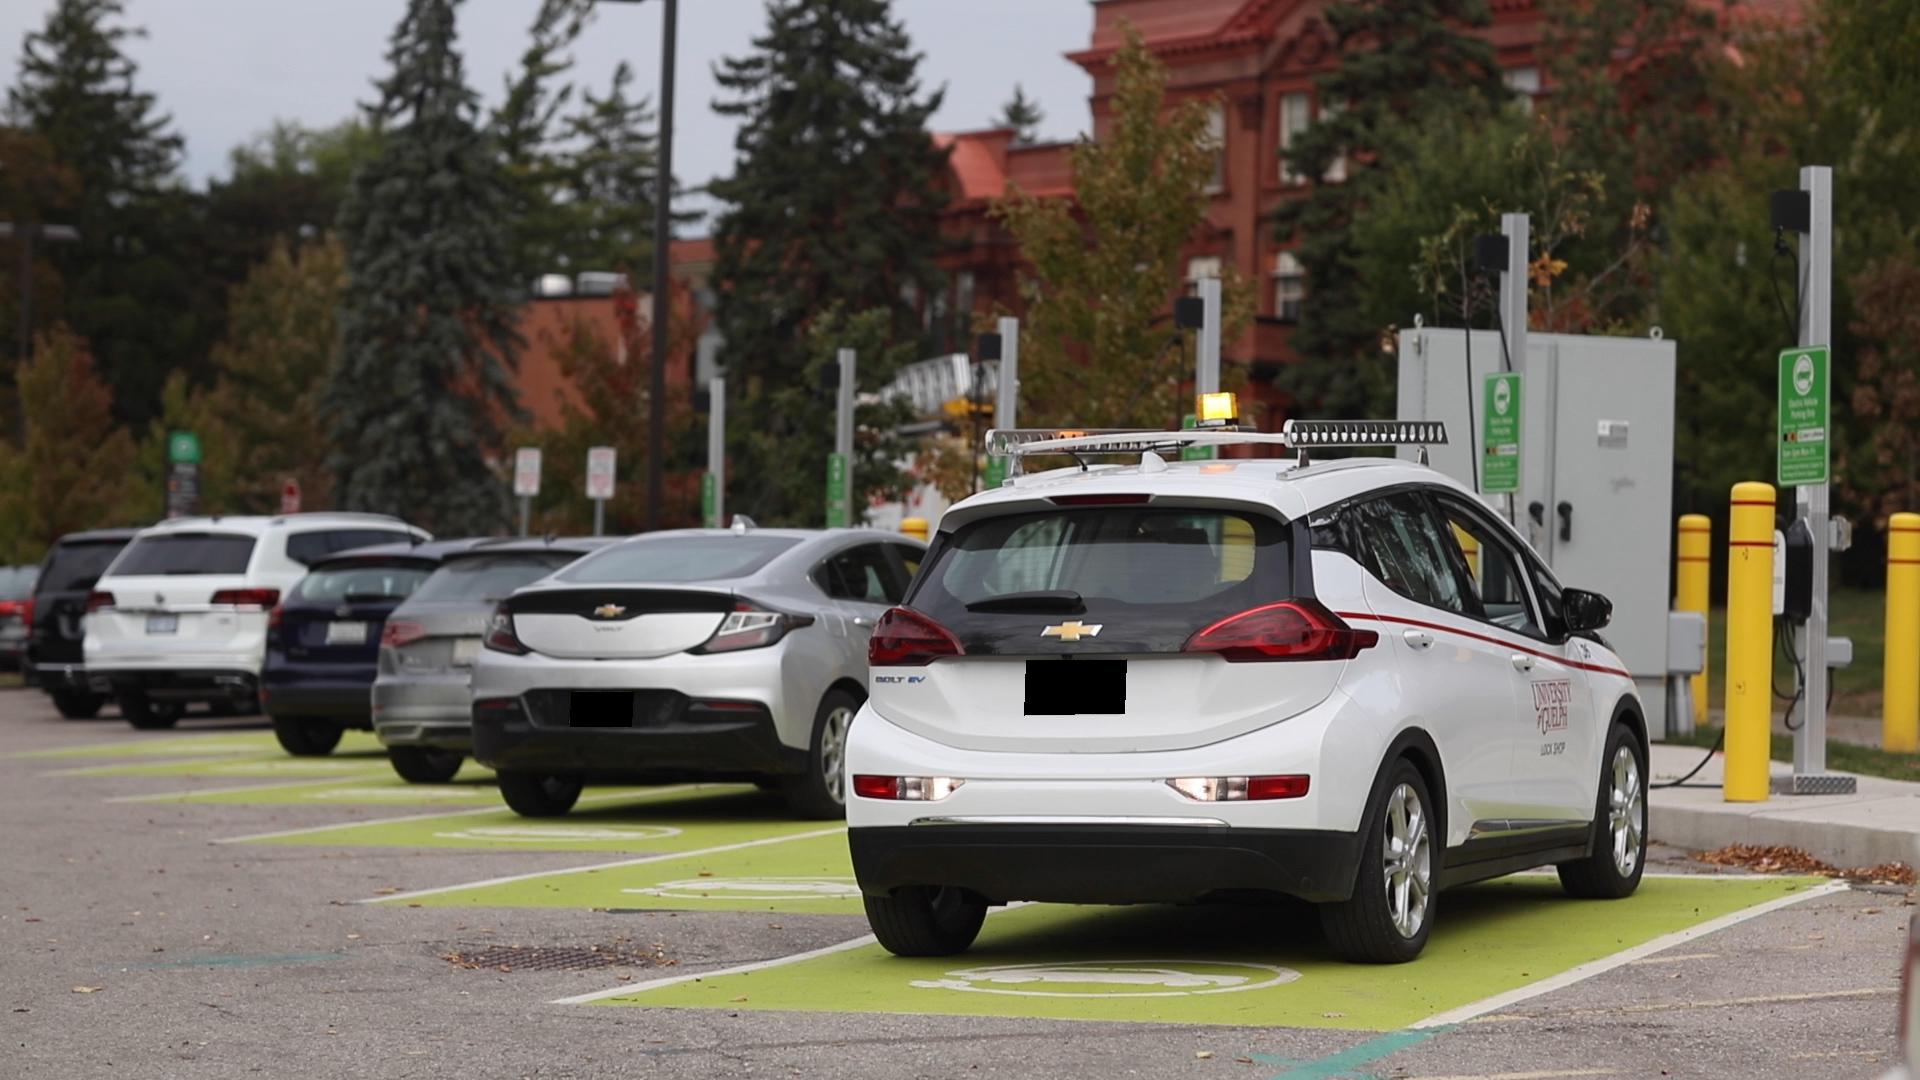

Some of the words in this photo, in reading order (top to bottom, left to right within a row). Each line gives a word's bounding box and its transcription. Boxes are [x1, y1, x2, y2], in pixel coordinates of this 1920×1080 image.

[875, 676, 905, 684] BOLT
[908, 676, 926, 684] EV
[1531, 682, 1571, 711] UNIVERSITY
[1541, 704, 1568, 736] GUELPH
[1553, 742, 1566, 755] SHOP
